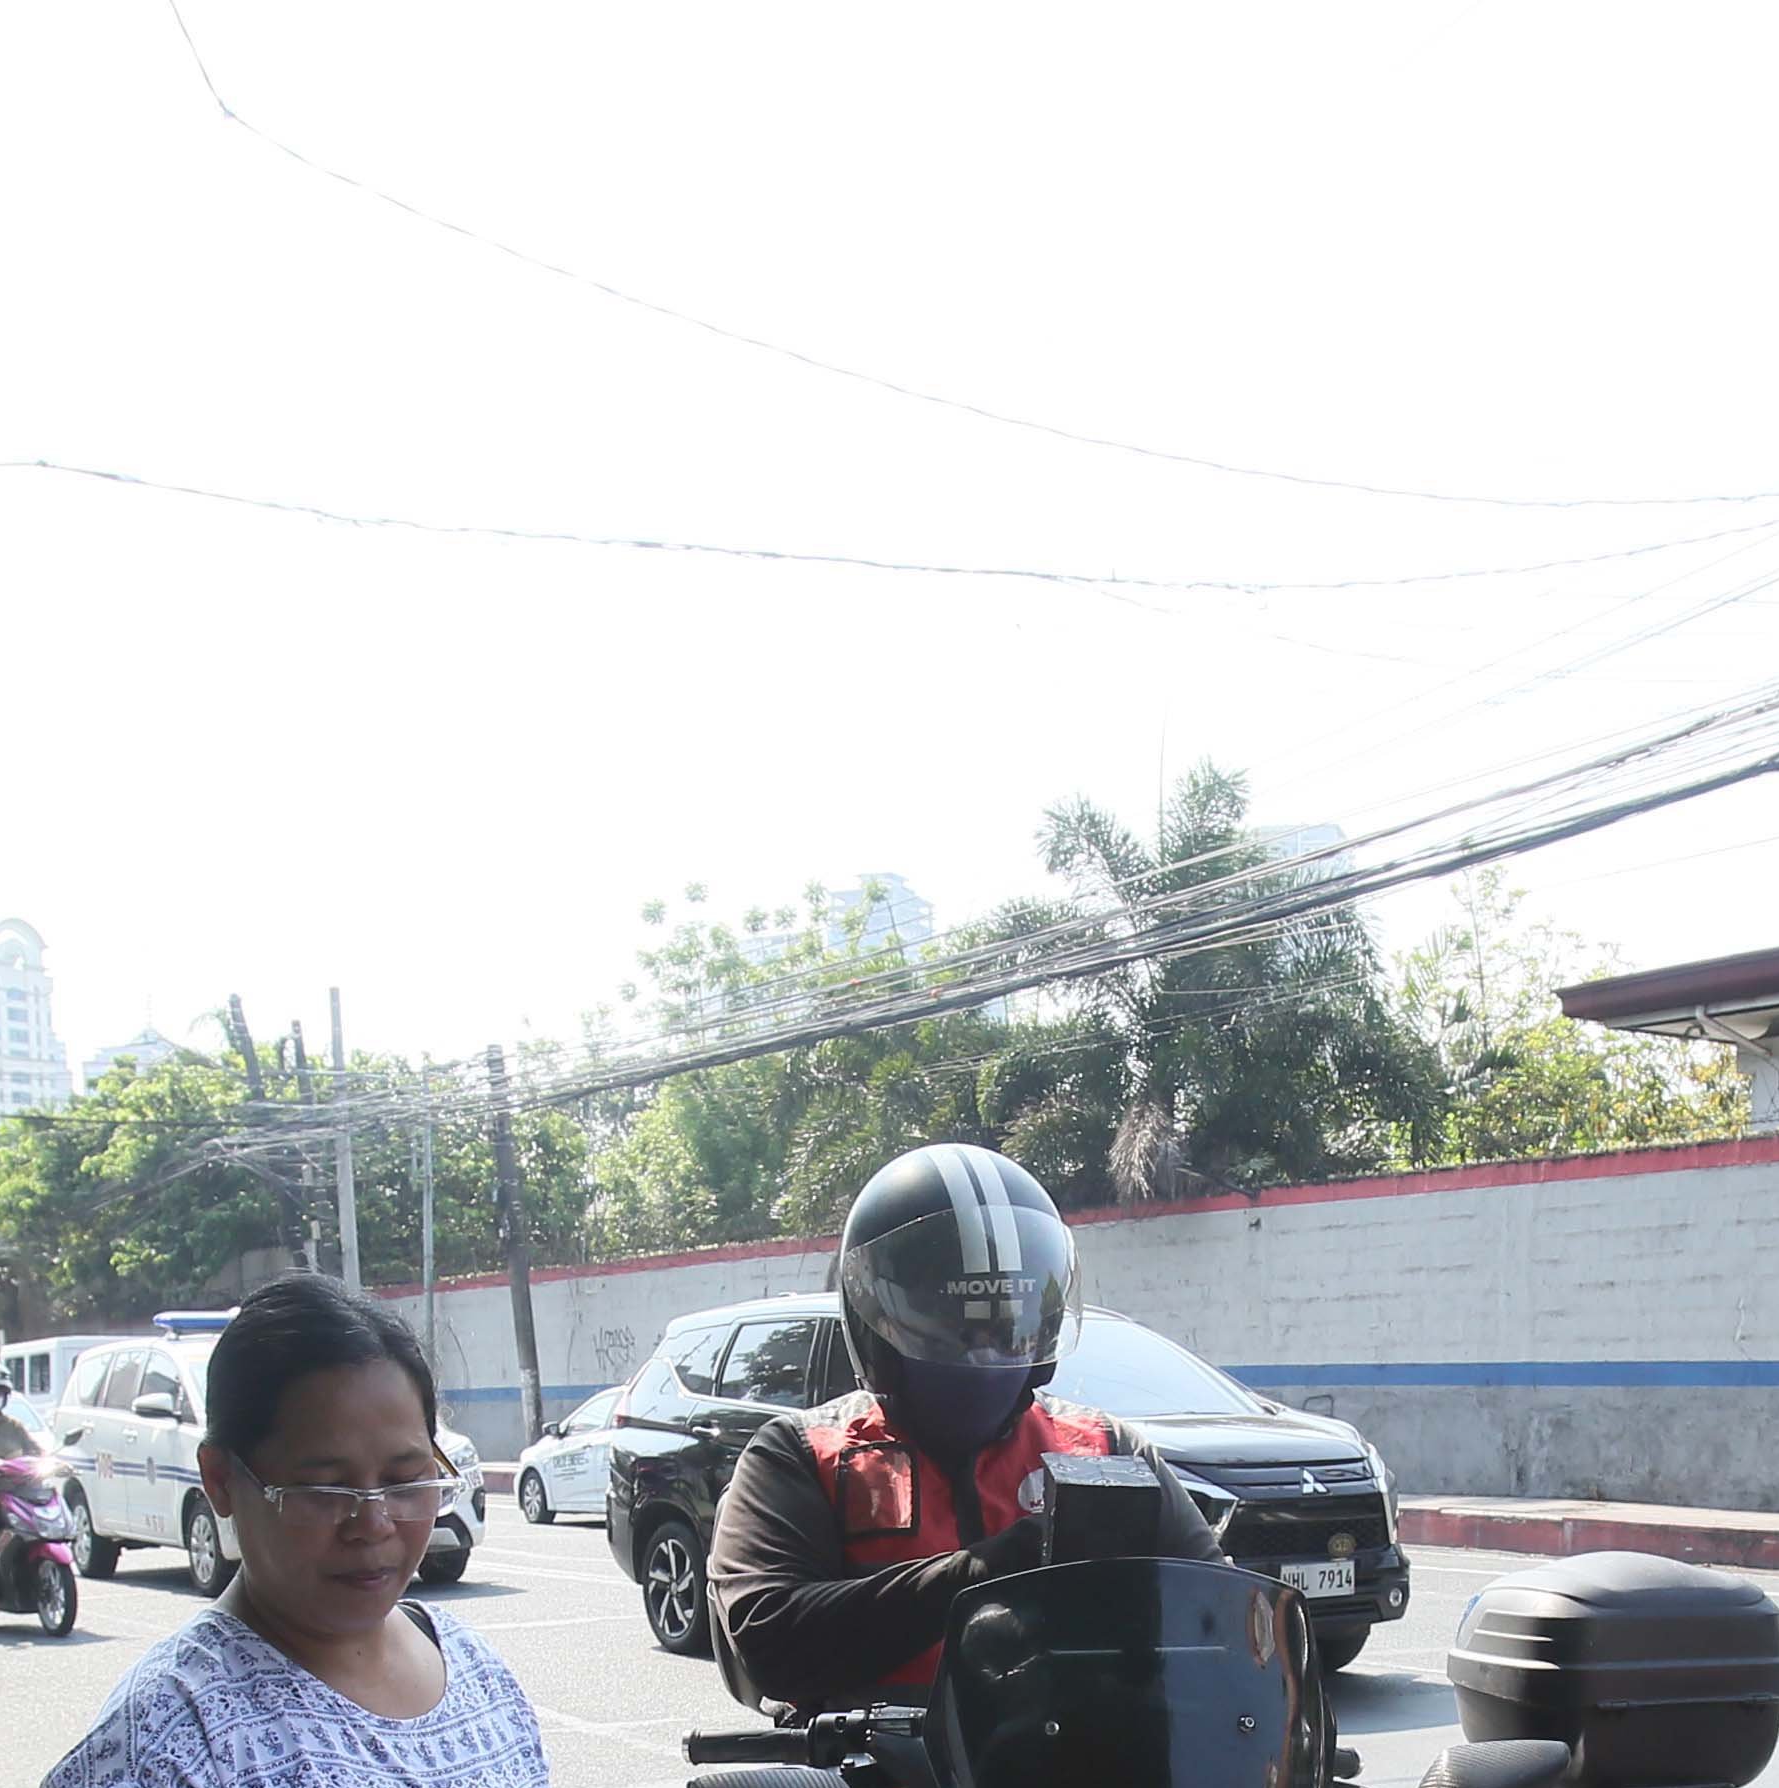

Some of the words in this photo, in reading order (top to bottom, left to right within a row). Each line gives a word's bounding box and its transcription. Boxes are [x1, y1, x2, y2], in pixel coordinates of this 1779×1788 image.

[946, 1279, 1014, 1295] MOVE
[1018, 1278, 1037, 1293] IT
[1318, 1568, 1353, 1590] 7914
